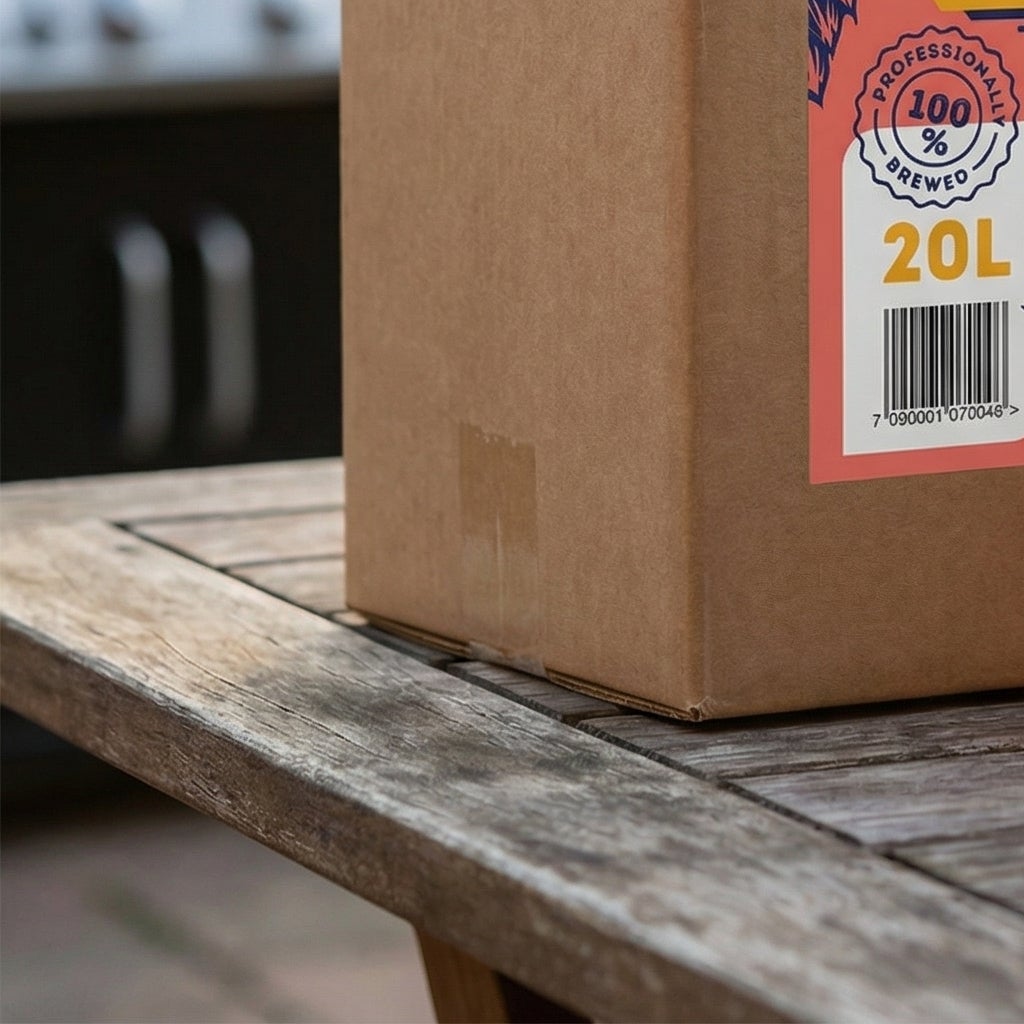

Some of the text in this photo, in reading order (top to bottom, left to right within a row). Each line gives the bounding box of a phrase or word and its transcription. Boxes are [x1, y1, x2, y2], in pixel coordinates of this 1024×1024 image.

[872, 43, 1005, 127] PROFESSIONALLY
[908, 89, 971, 128] 100
[886, 156, 968, 192] BREWED
[883, 218, 1011, 283] 20L
[872, 414, 881, 428] 7
[889, 409, 942, 426] 090001
